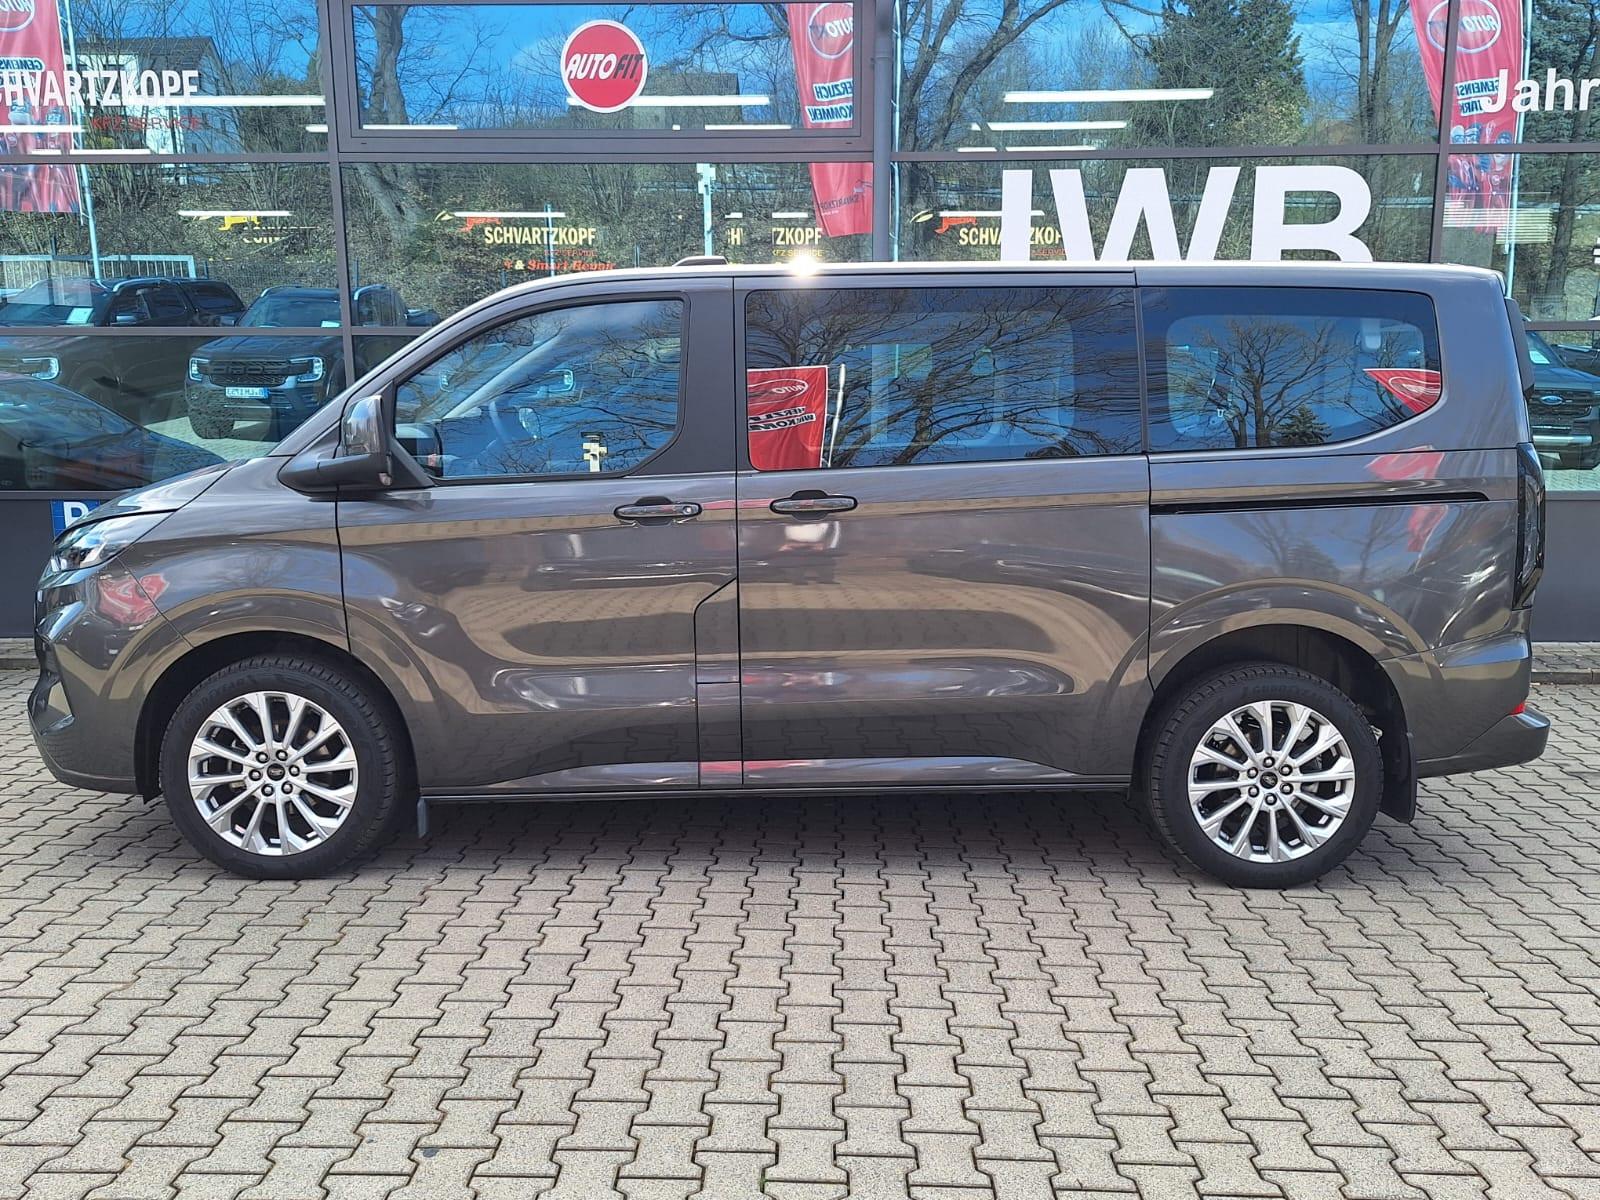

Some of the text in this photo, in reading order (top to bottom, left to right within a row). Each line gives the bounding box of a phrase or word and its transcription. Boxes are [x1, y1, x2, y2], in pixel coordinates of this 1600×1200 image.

[0, 69, 199, 106] HVARTZKOPF
[1481, 69, 1600, 112] Jahr
[484, 226, 596, 245] SCHVARTZKOPF
